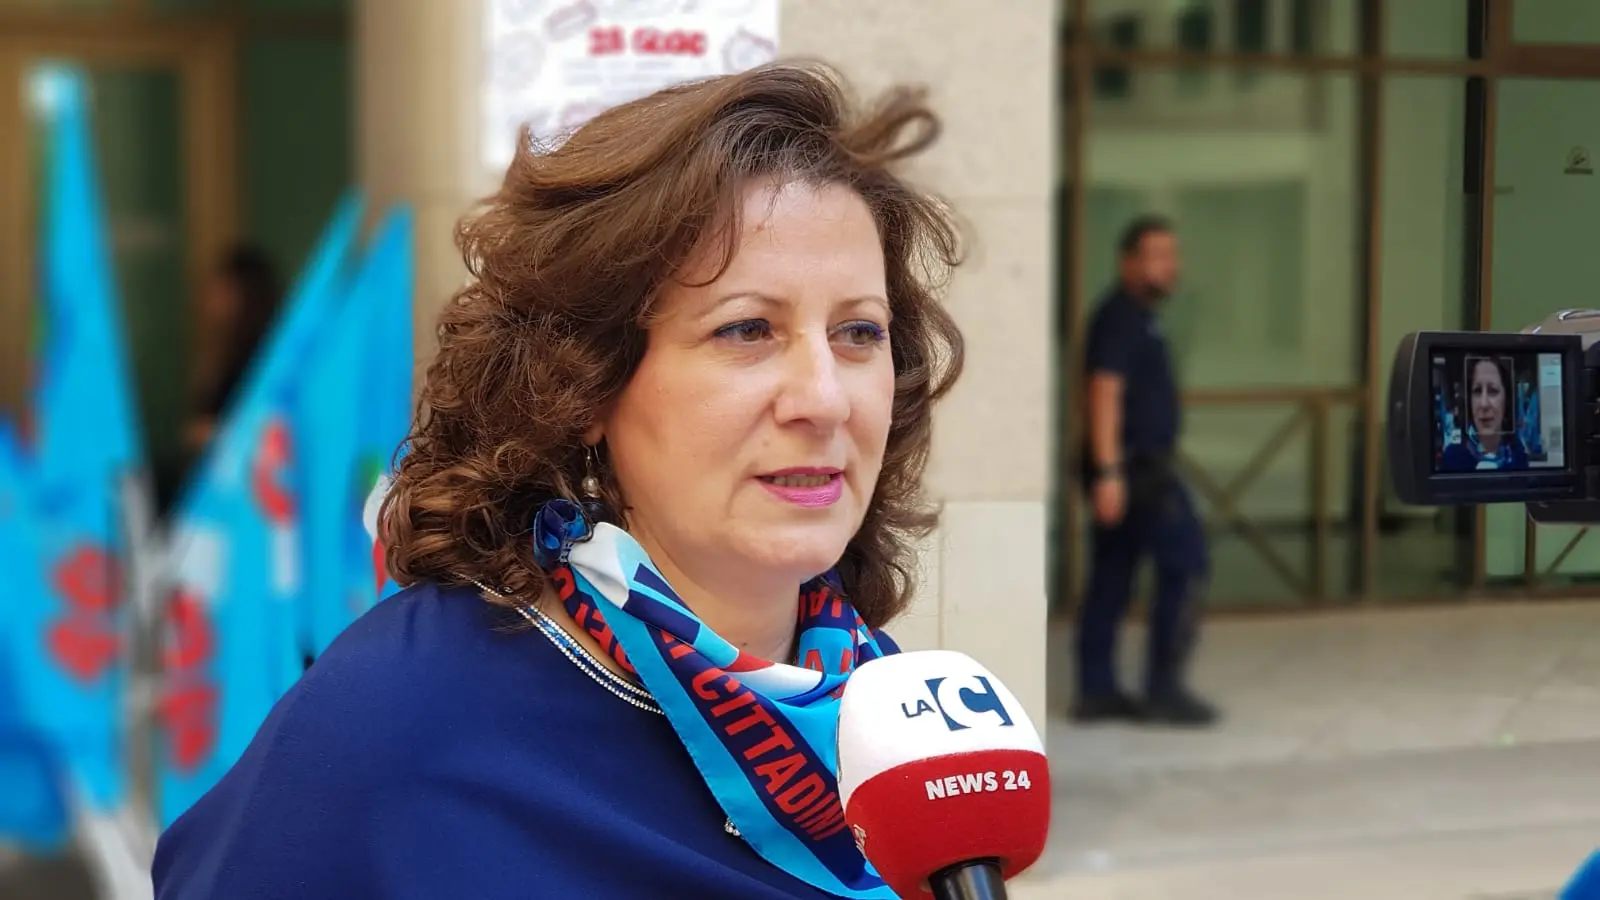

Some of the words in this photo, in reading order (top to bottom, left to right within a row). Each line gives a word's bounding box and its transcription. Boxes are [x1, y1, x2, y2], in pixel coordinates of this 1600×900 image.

[901, 699, 936, 719] LA
[692, 667, 847, 841] CITTADINI
[924, 771, 999, 801] NEWS
[1002, 769, 1031, 790] 24
